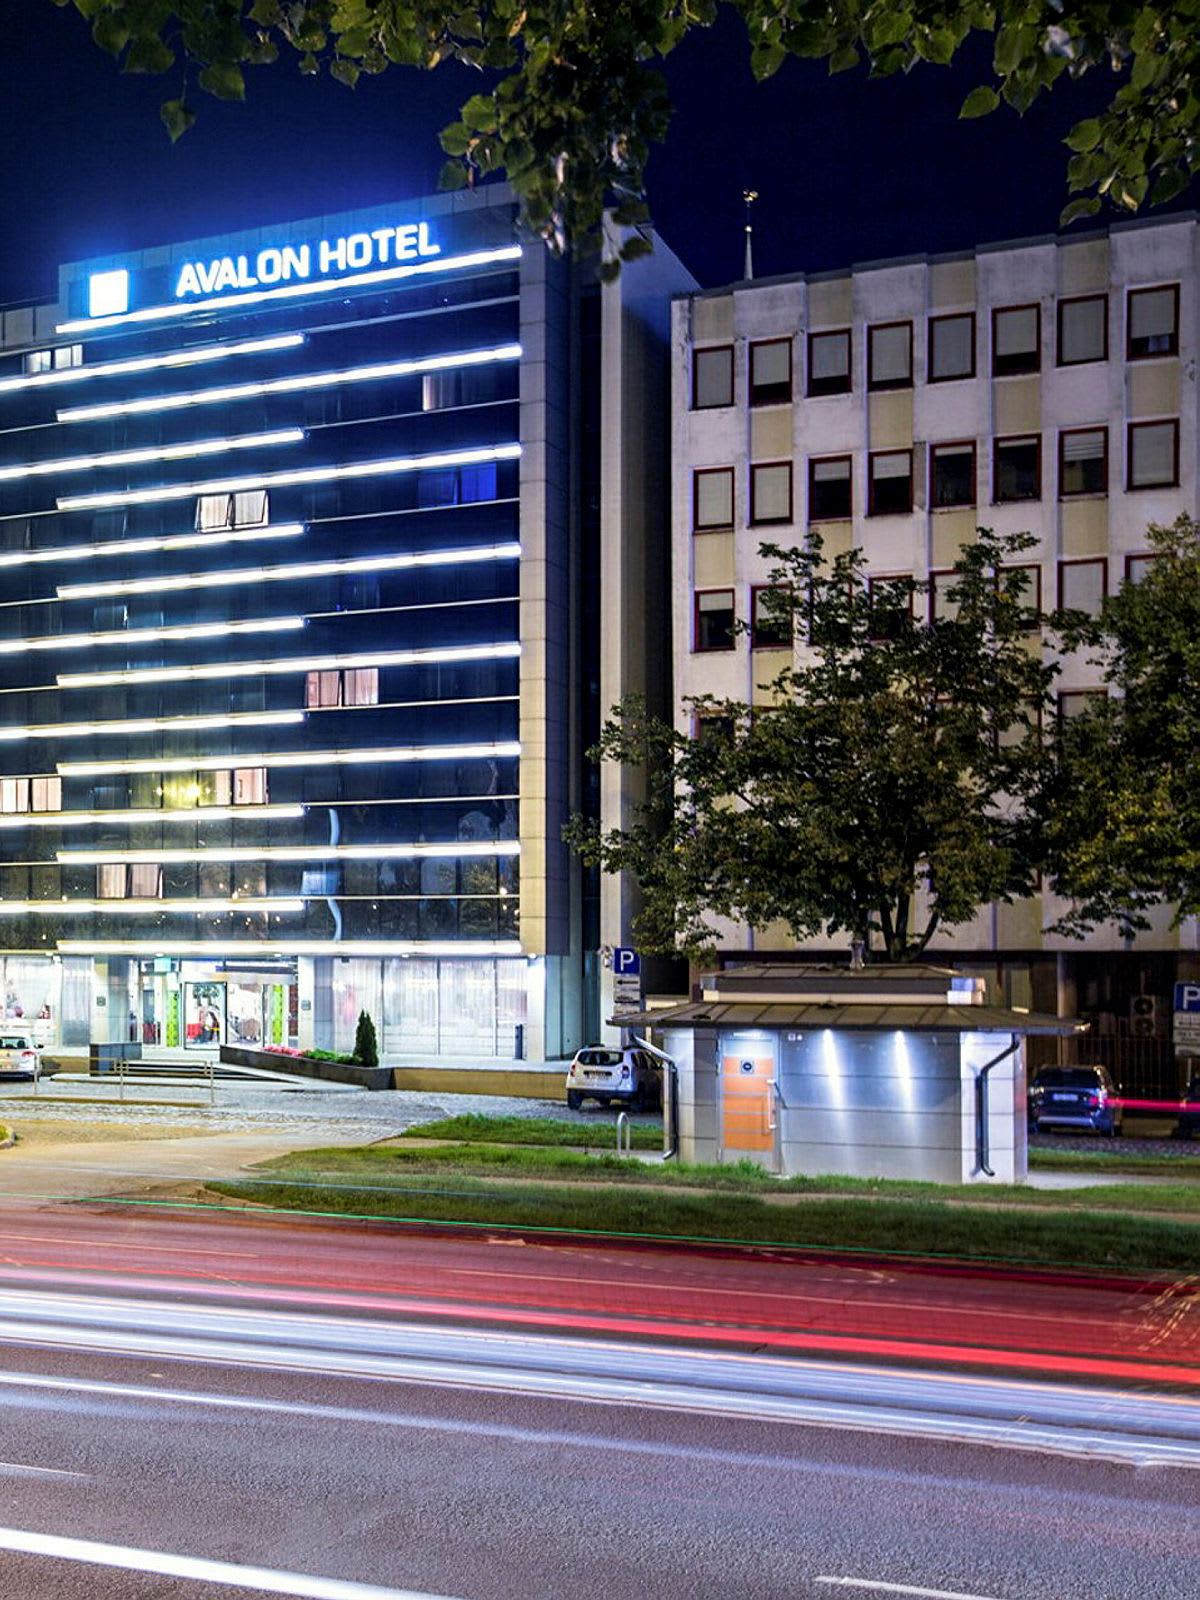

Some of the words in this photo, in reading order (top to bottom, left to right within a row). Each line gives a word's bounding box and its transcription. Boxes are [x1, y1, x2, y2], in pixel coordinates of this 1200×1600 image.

[175, 244, 310, 297] AVALON
[319, 221, 441, 273] HOTEL
[620, 950, 634, 971] P
[1182, 985, 1200, 1010] P
